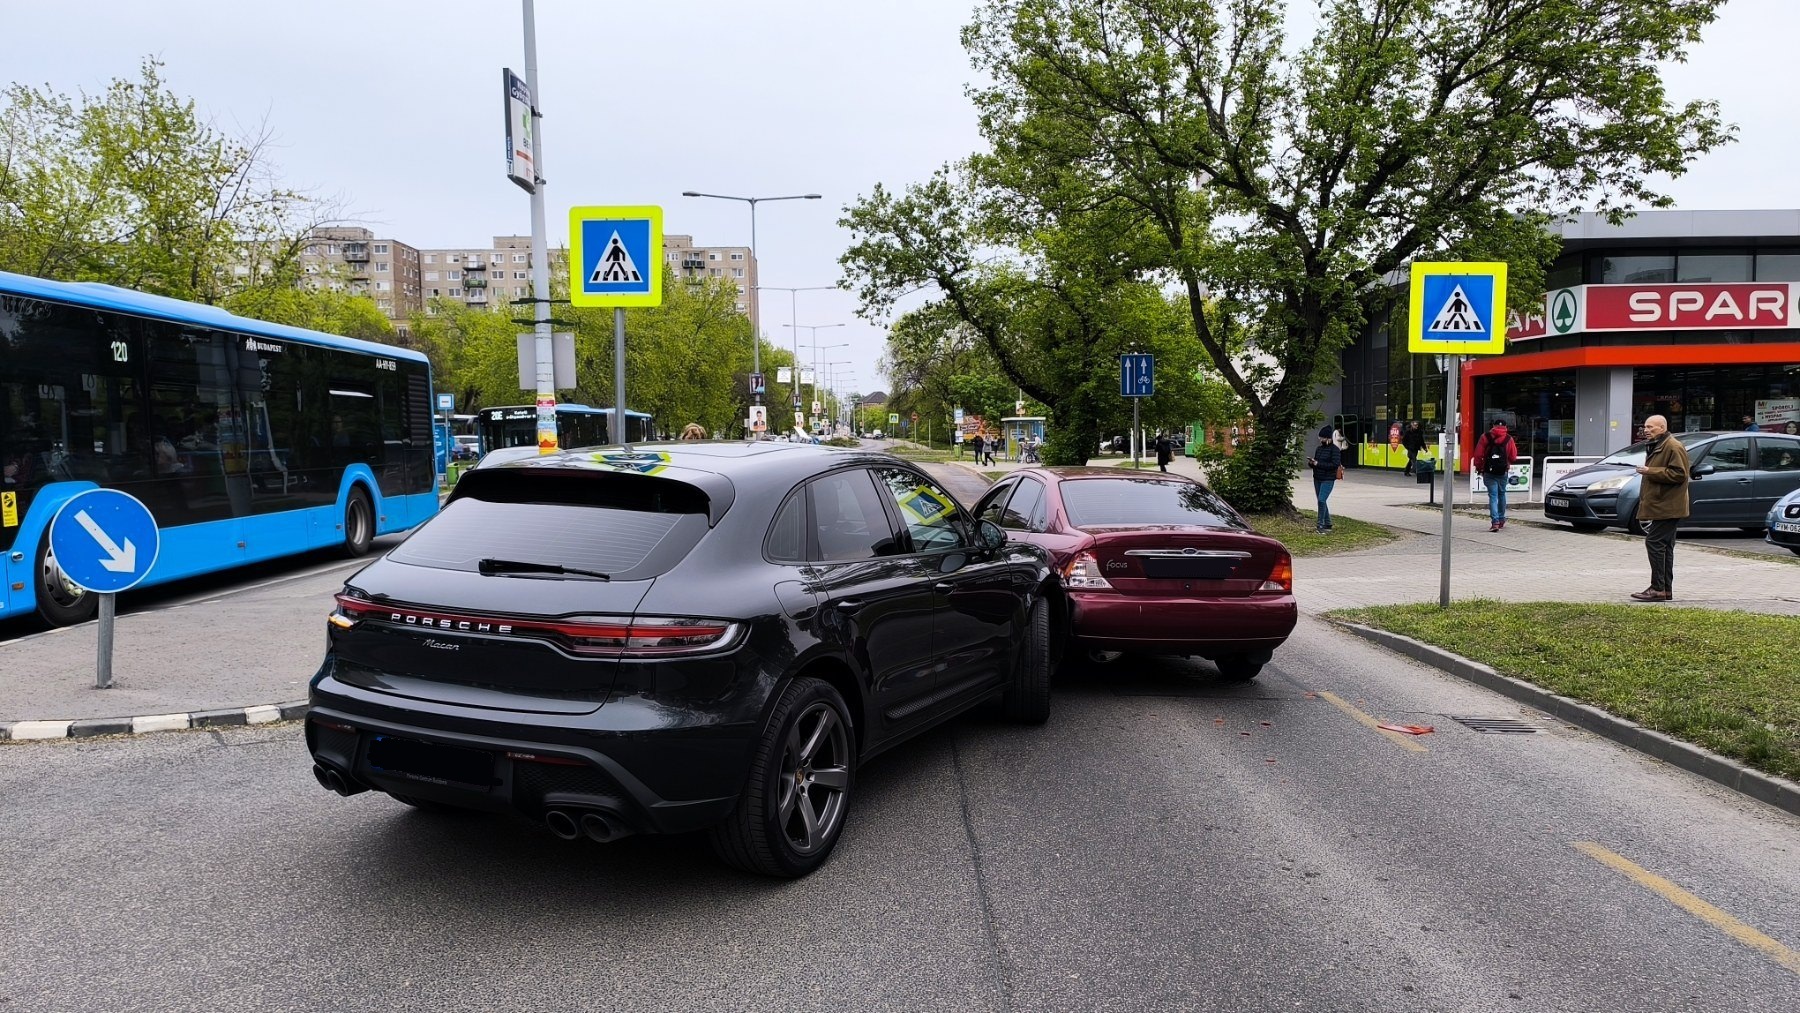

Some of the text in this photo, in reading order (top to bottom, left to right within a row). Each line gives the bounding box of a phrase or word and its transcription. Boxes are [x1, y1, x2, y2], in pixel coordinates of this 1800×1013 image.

[1629, 290, 1785, 322] SPAR
[111, 341, 128, 362] 120
[257, 342, 282, 353] BUDAPEST
[391, 613, 512, 633] PORSCHE
[422, 638, 460, 650] Macan
